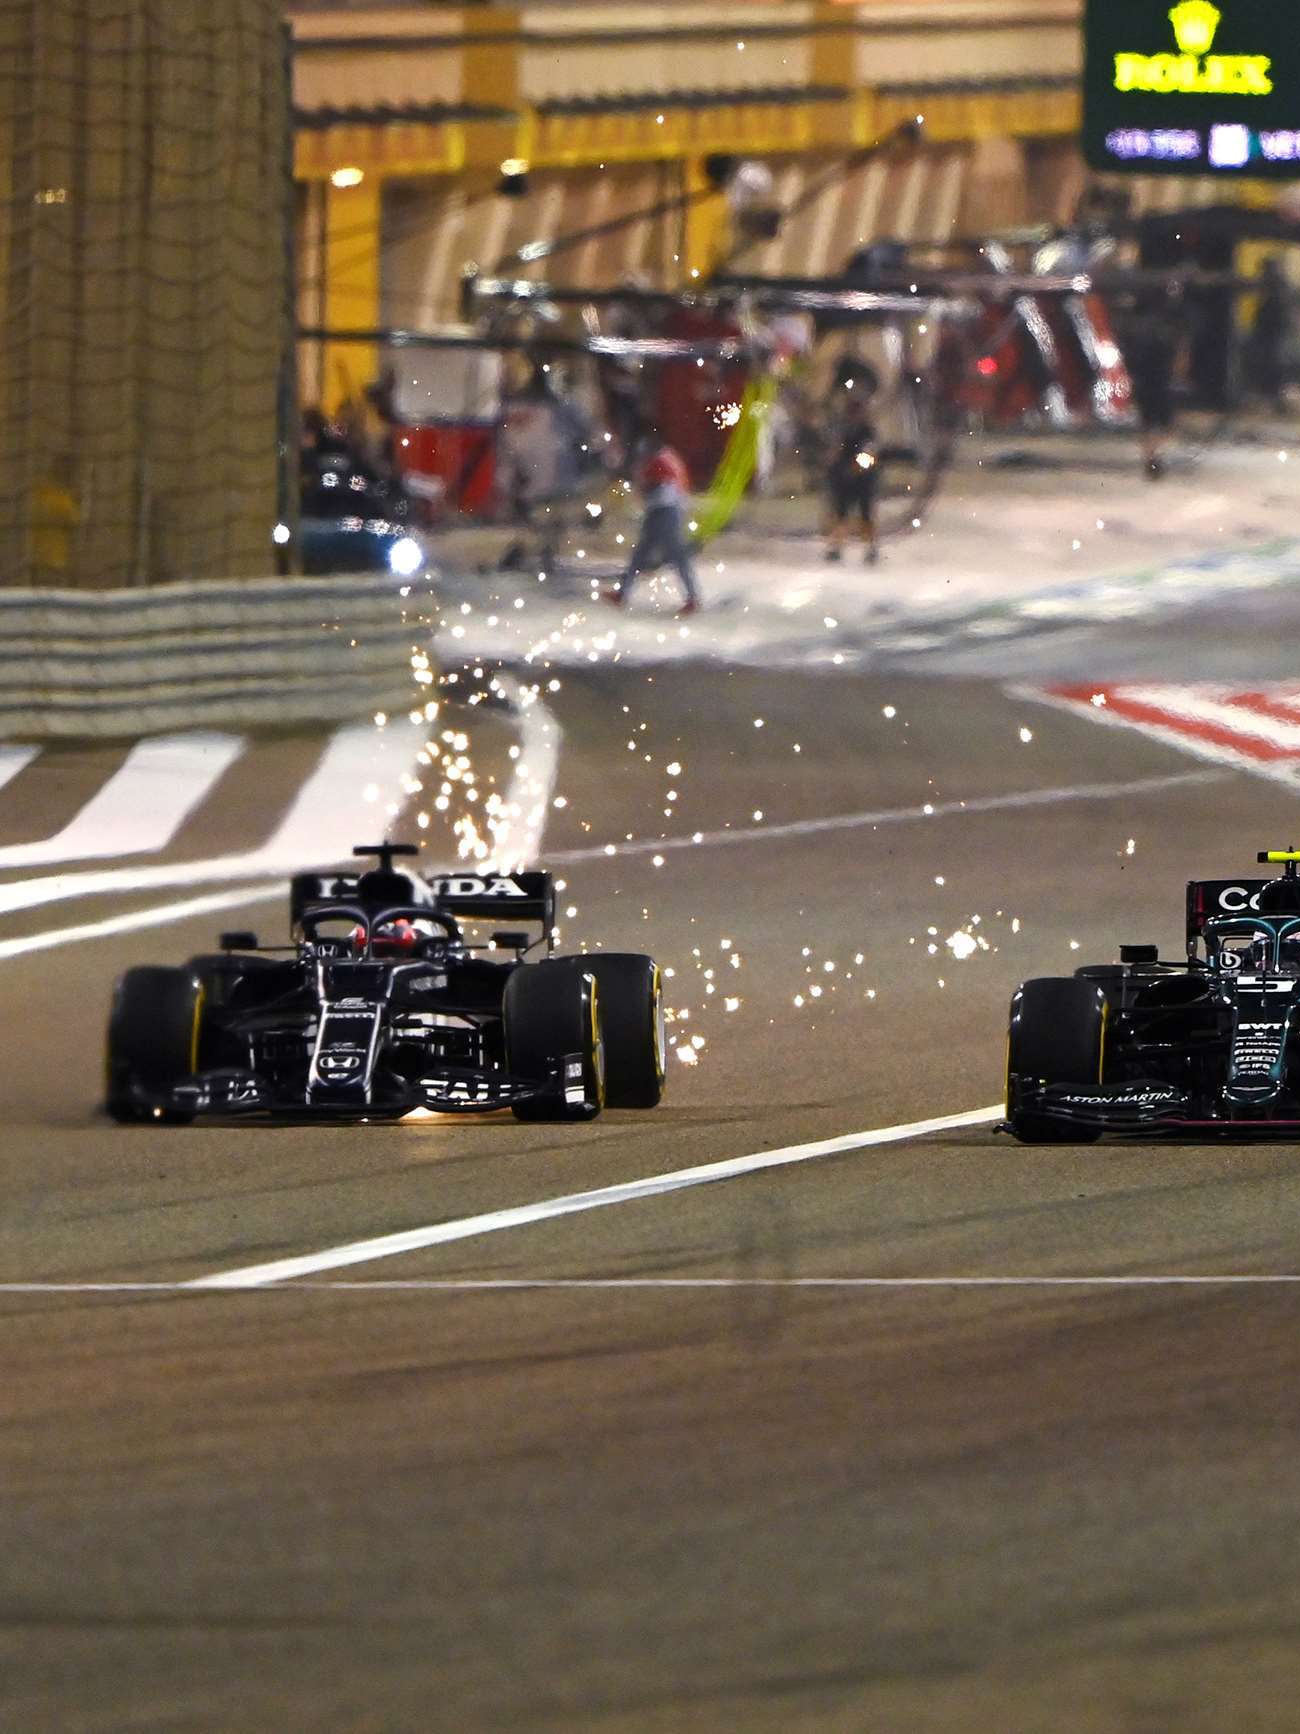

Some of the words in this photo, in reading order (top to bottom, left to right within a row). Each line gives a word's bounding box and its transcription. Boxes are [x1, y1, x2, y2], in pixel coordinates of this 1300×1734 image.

[1114, 52, 1273, 95] ROLEX
[1059, 1095, 1113, 1104] ASTON
[1114, 1091, 1174, 1103] MARTIN
